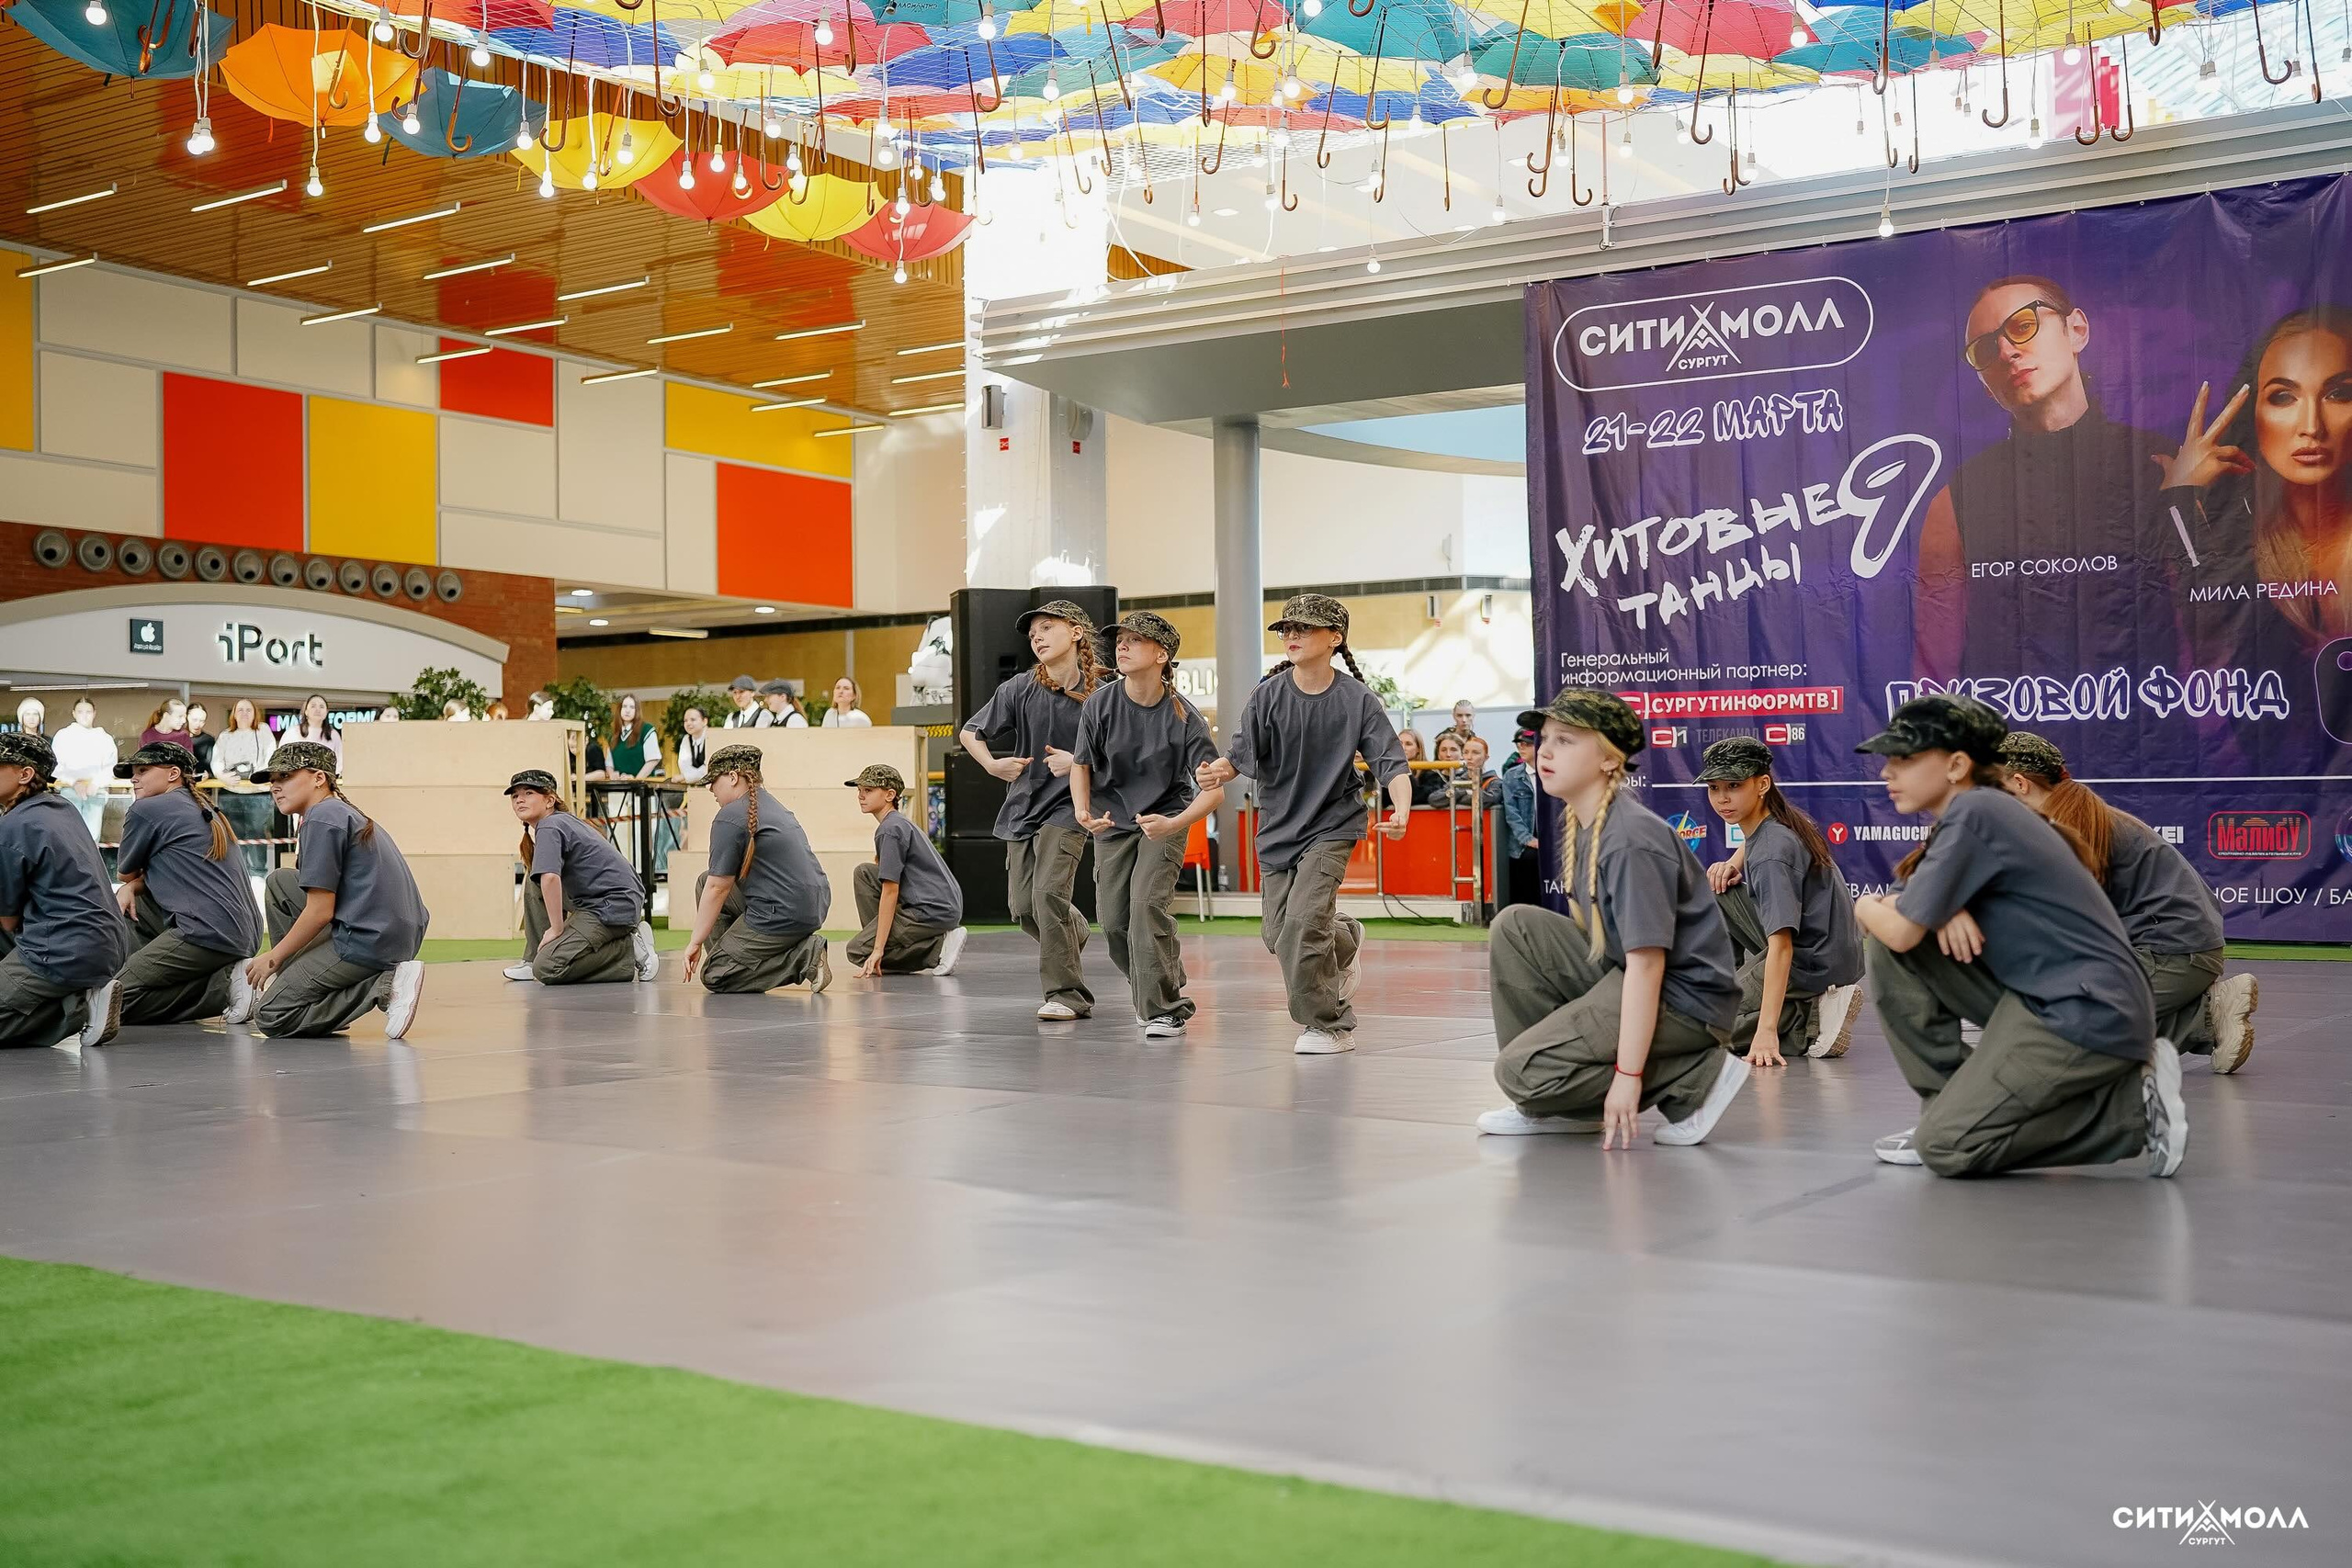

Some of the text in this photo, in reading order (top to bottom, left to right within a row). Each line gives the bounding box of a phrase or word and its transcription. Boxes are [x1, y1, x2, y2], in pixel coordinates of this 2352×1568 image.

[1678, 355, 1728, 370] СУРГУТ
[1582, 389, 1844, 455] 21-22 МАРТА
[1555, 483, 1840, 597] ХИТОВЫЕ
[1971, 555, 2119, 578] ЕГОР СОКОЛОВ
[1618, 542, 1801, 629] ТАНЦЫ
[2189, 580, 2339, 603] МИЛА РЕДИНА
[215, 621, 323, 668] iPort
[1561, 648, 1669, 670] Генеральный
[1561, 662, 1808, 687] информационный партнер:
[2138, 665, 2290, 721] ФОНД
[2255, 886, 2307, 905] ШОУ
